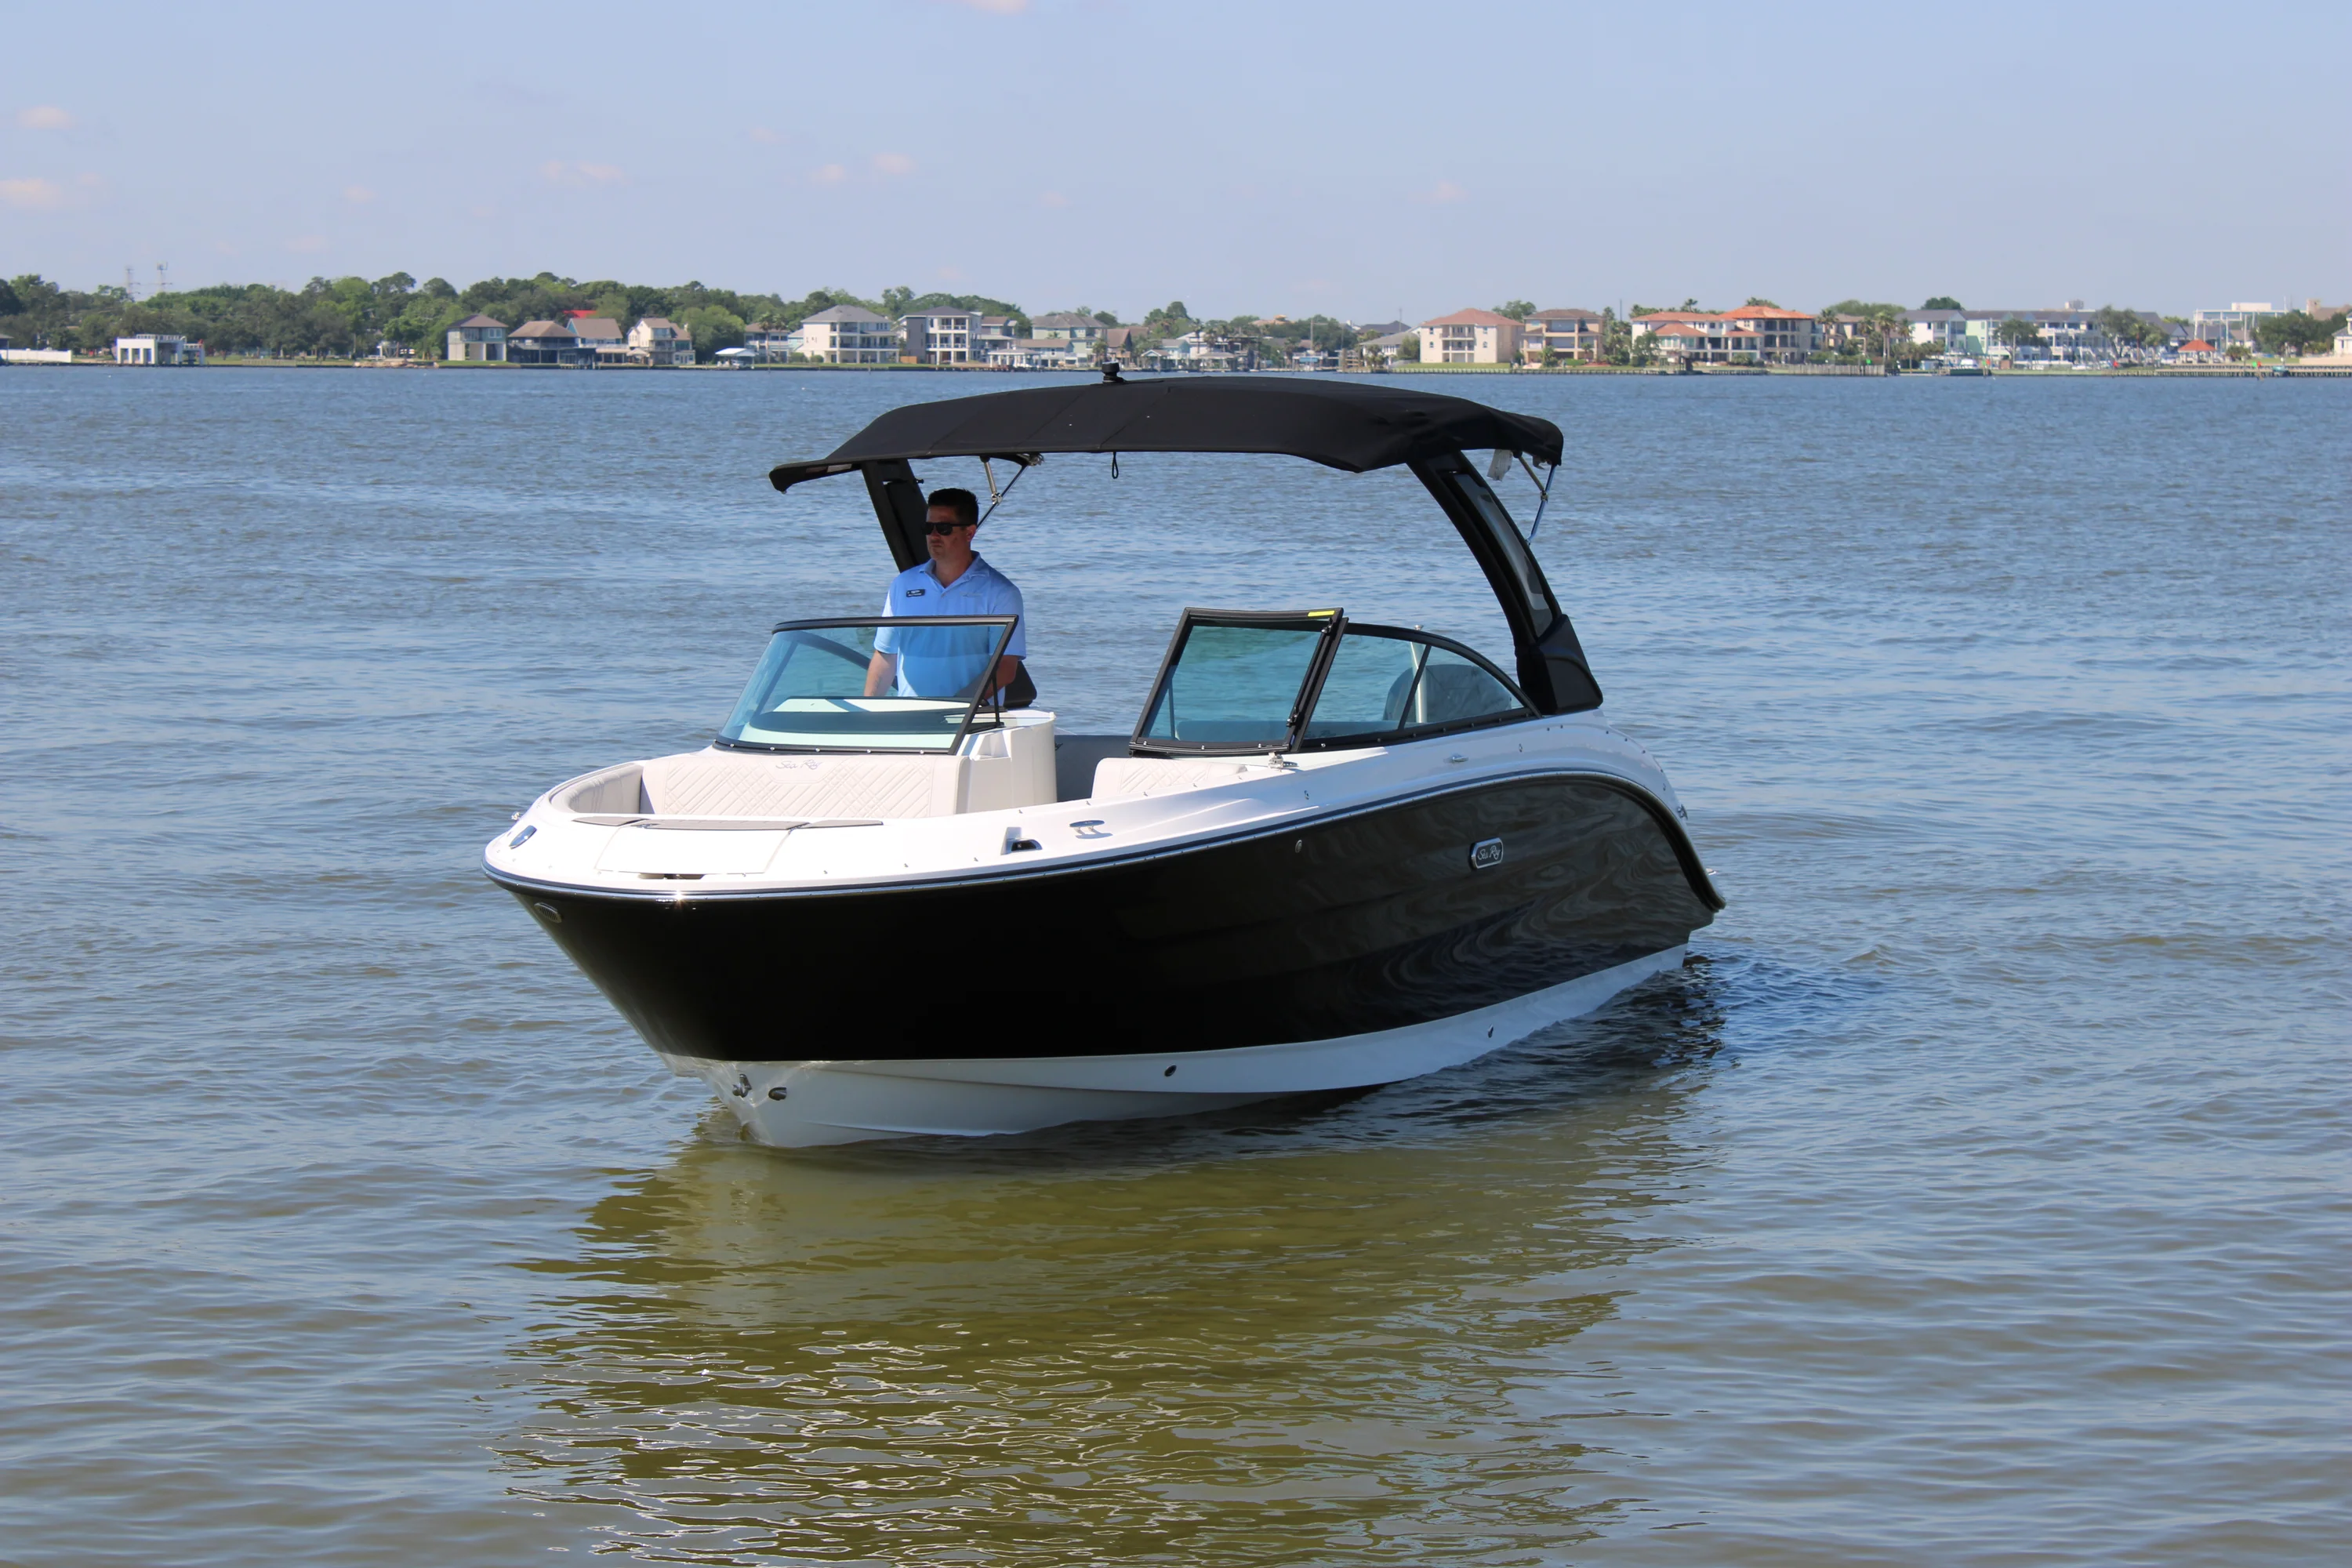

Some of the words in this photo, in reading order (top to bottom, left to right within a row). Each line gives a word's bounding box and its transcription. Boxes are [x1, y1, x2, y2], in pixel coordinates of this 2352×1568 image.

[775, 760, 799, 769] Sea
[800, 759, 823, 770] Ray
[1477, 849, 1489, 860] Sea
[1489, 845, 1501, 860] Ray
